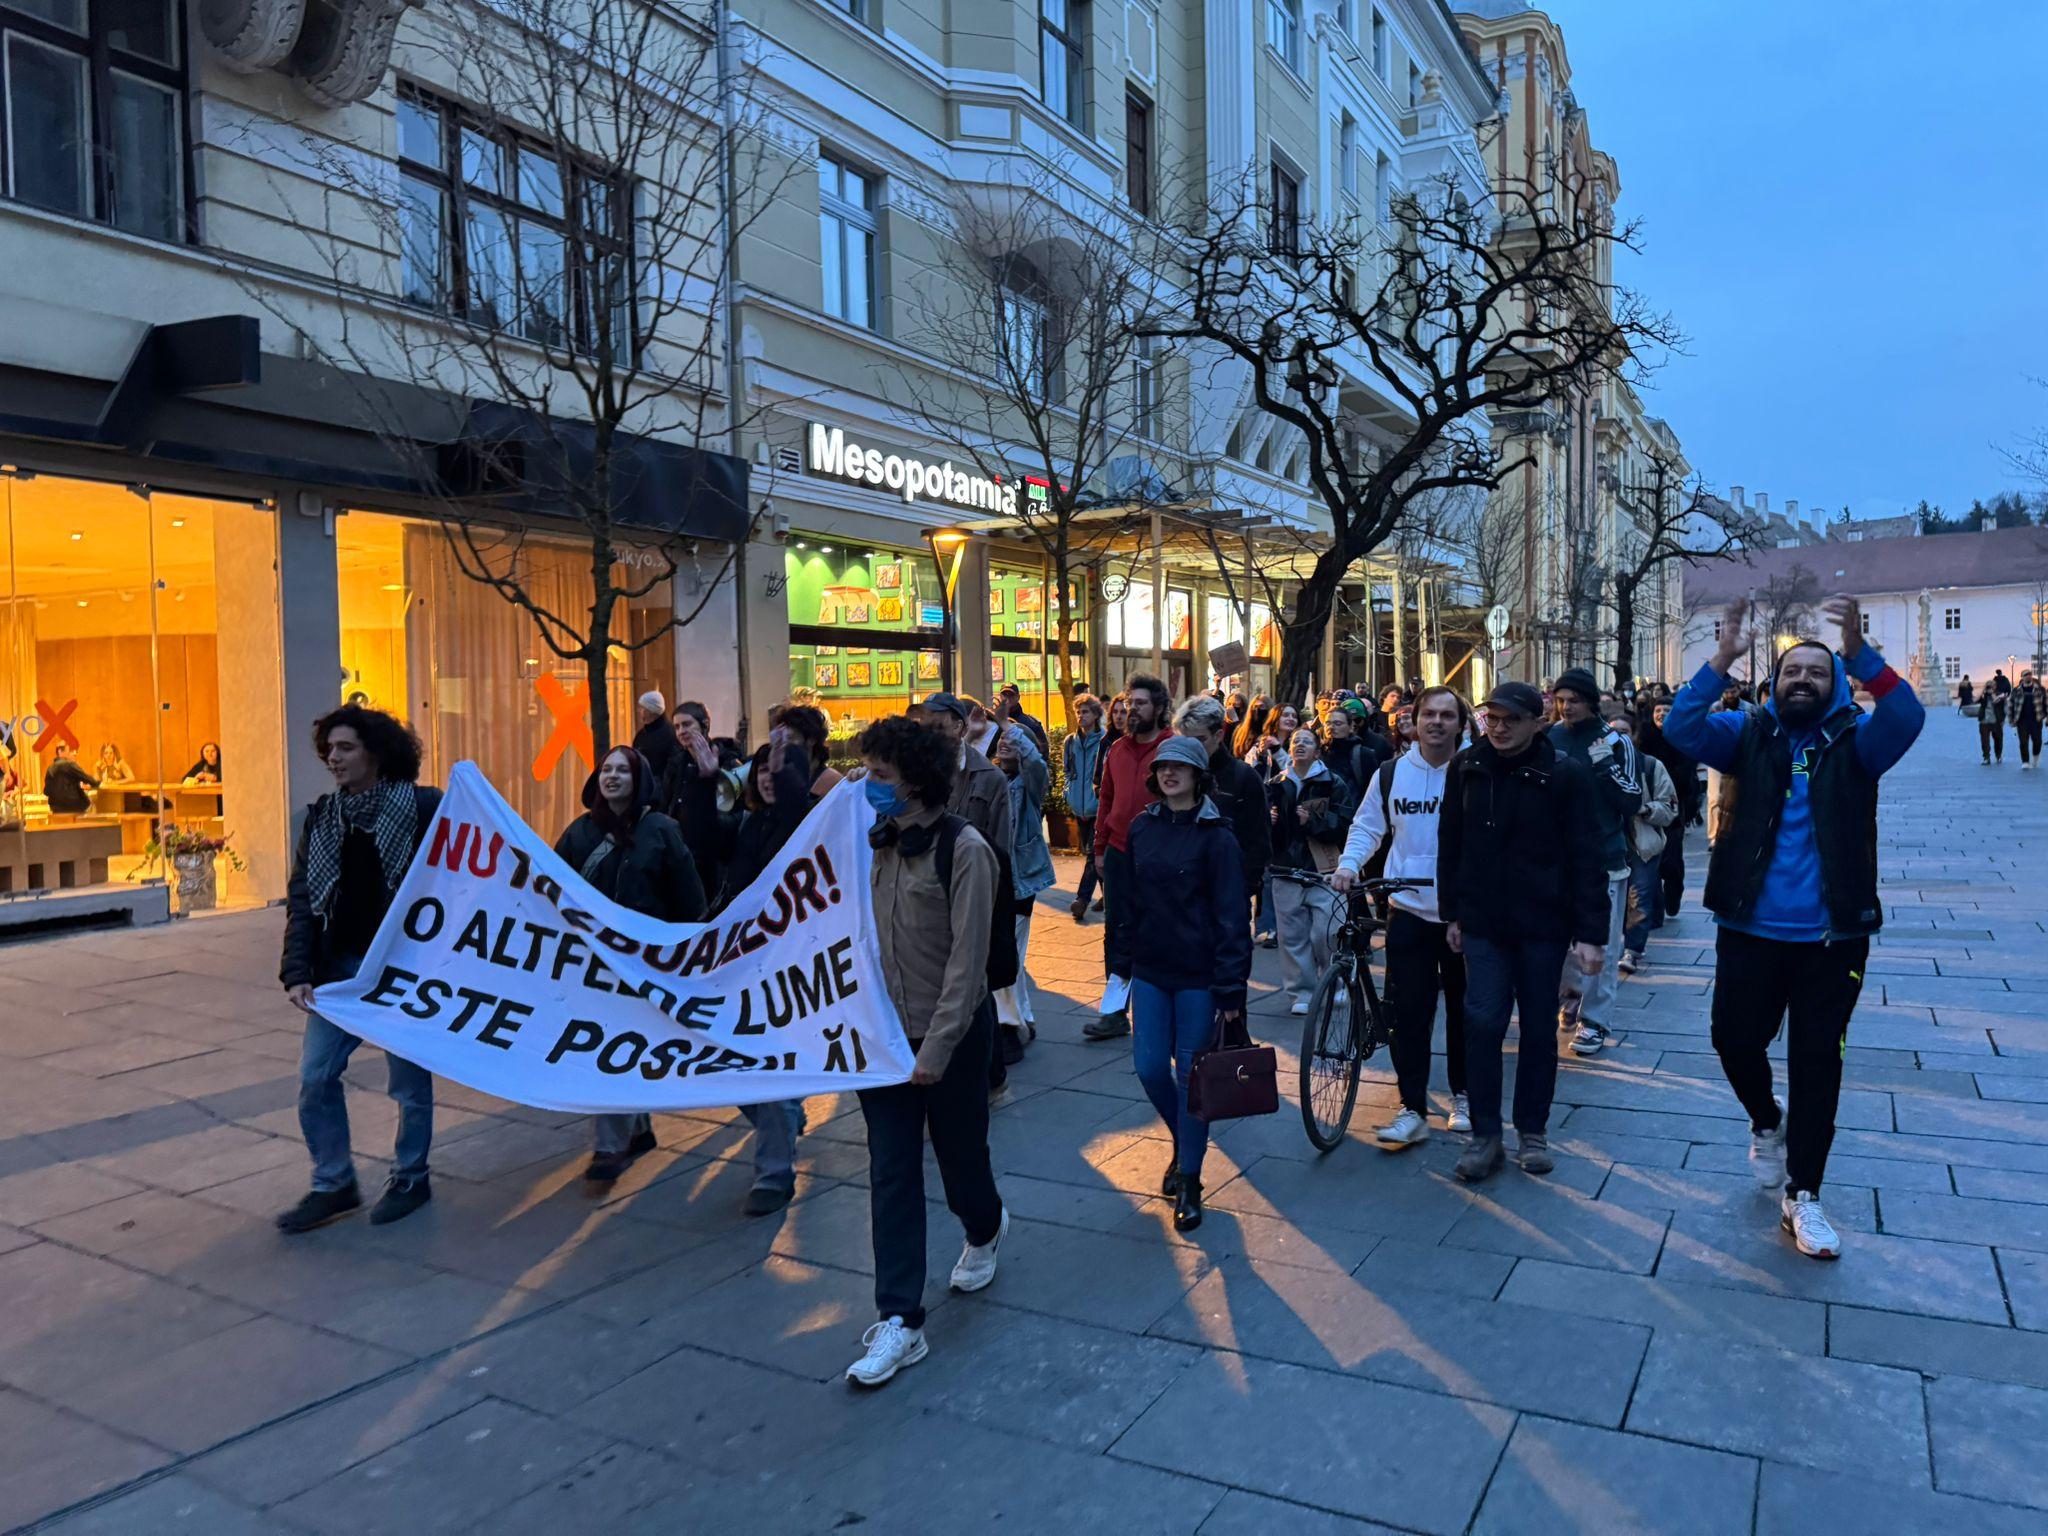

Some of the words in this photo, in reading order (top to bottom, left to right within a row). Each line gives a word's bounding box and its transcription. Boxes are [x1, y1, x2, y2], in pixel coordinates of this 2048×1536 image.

[811, 423, 1017, 515] Mesopotamia
[426, 816, 504, 878] NU
[360, 964, 535, 1051] ESTE
[403, 896, 445, 942] O
[732, 936, 859, 1036] LUME
